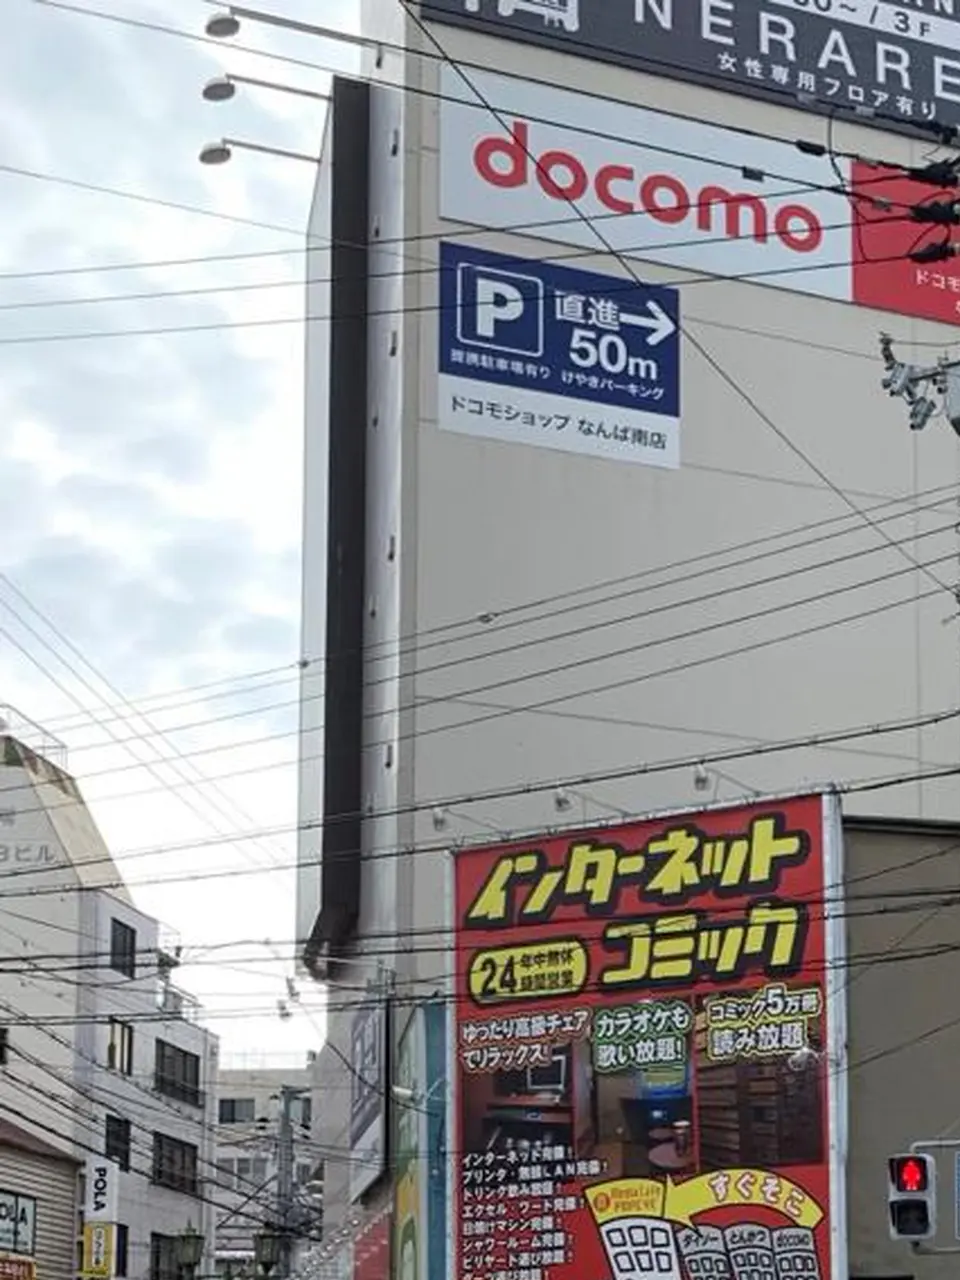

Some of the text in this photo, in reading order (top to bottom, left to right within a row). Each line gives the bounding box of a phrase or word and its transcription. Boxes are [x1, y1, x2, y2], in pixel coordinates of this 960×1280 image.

[473, 121, 822, 252] docomo
[555, 290, 620, 331] 直進
[569, 328, 658, 381] 50m
[451, 395, 571, 431] ドコモショップ
[469, 818, 802, 920] インターネット
[602, 903, 799, 984] コミック
[94, 1167, 108, 1212] POLA
[709, 1171, 804, 1217] すぐそこ
